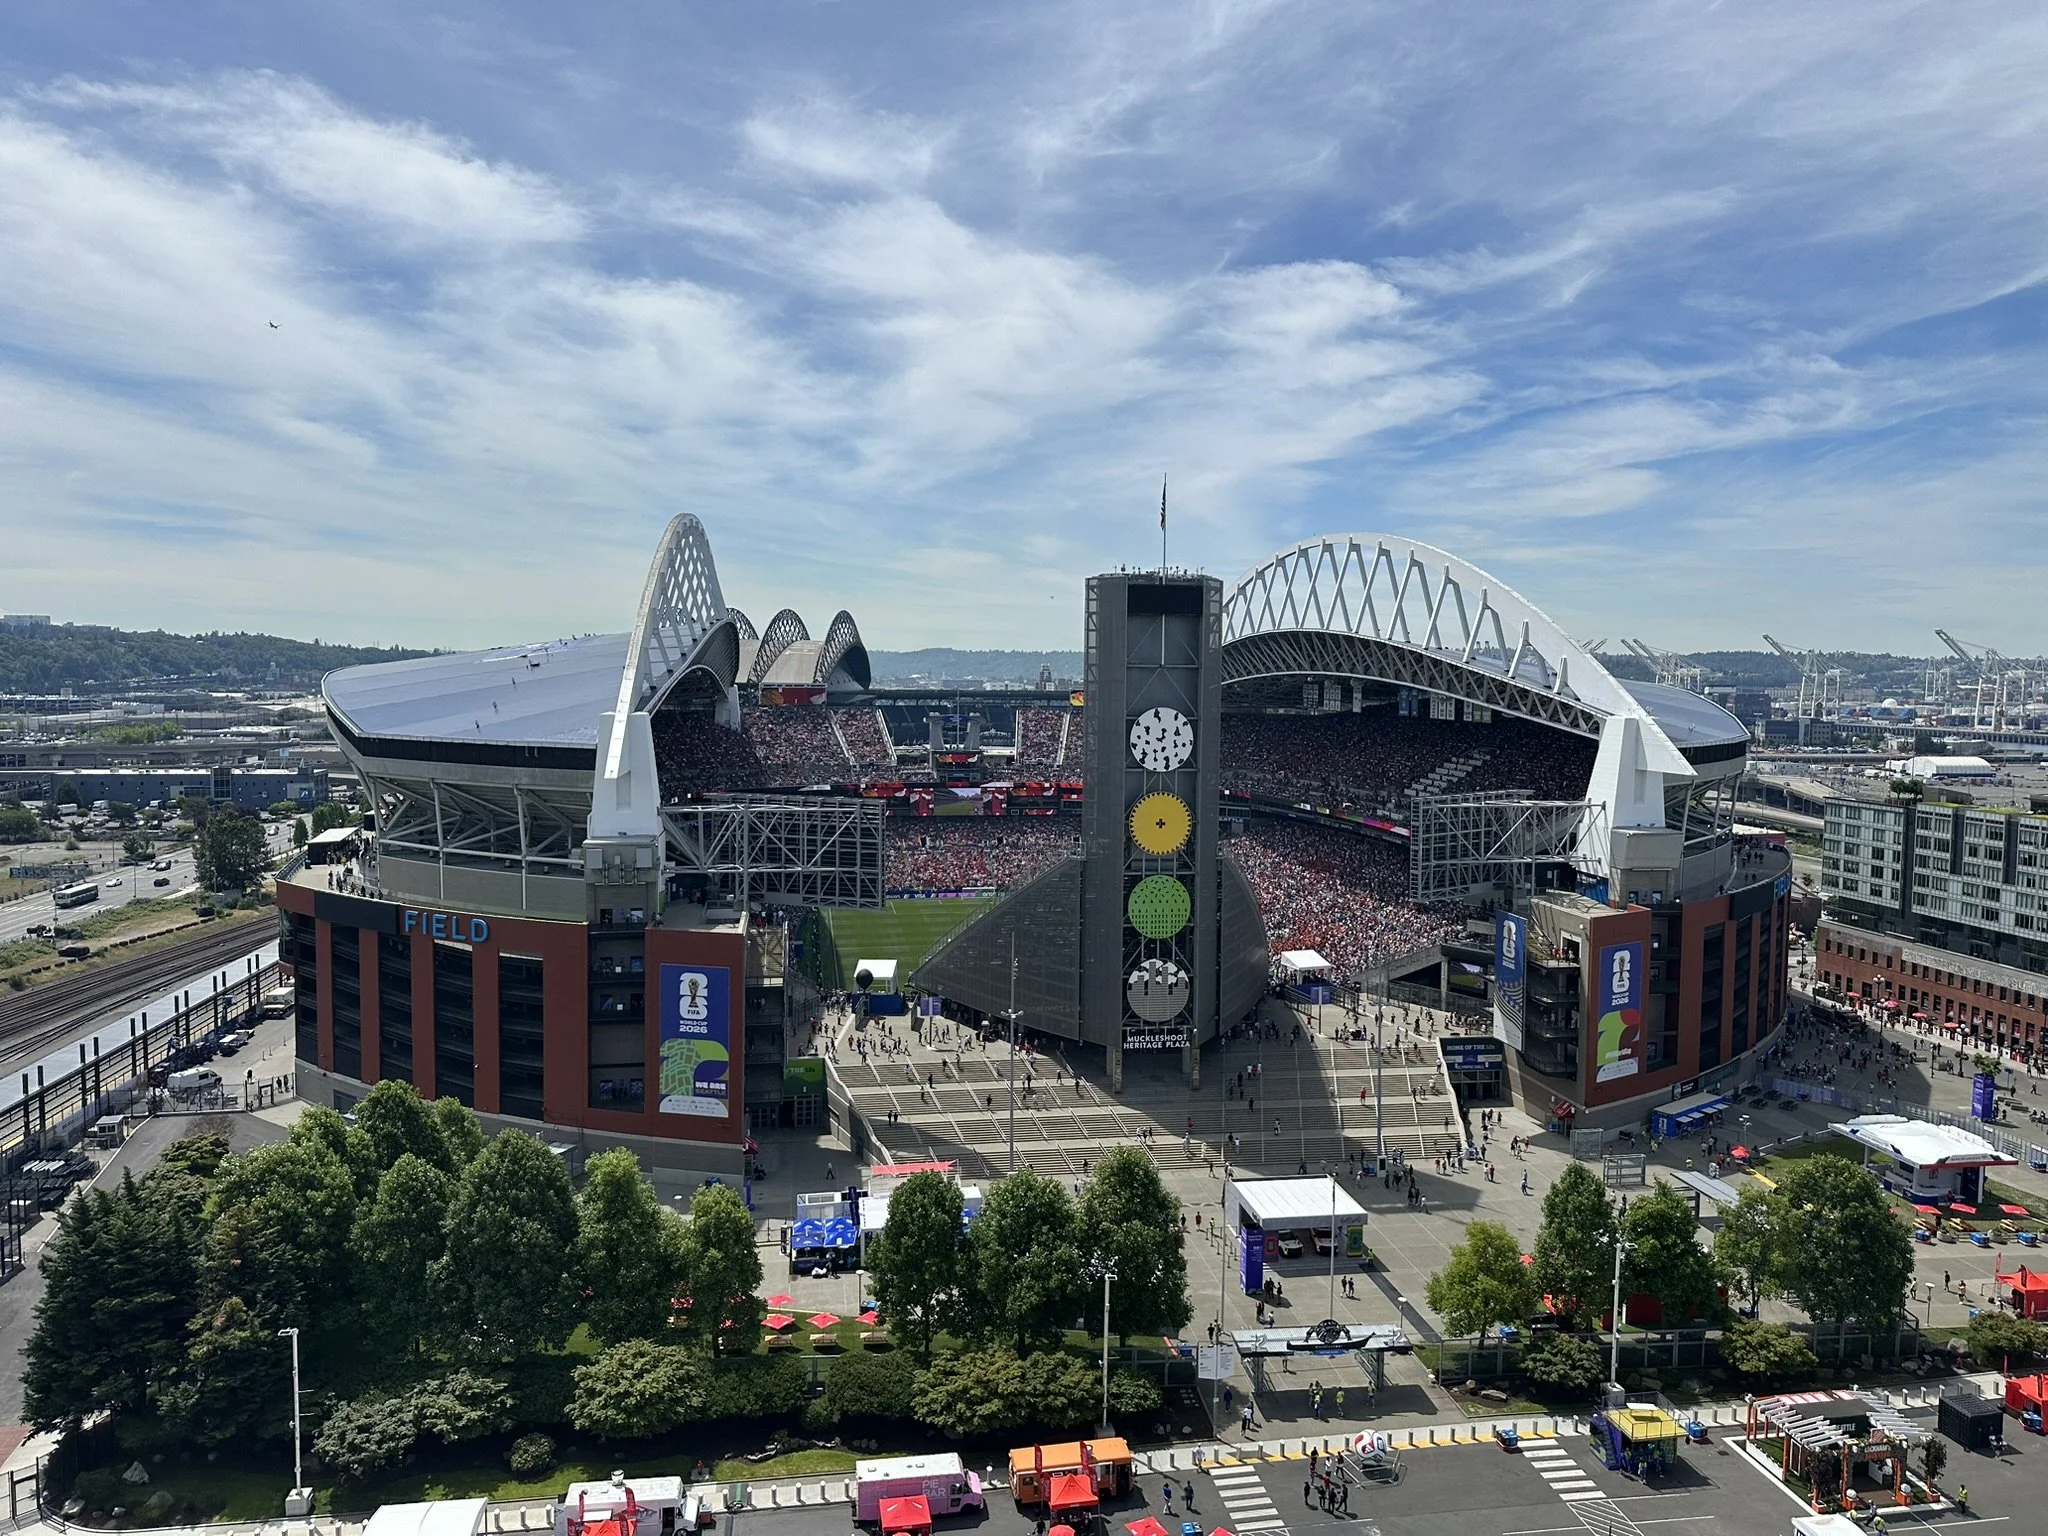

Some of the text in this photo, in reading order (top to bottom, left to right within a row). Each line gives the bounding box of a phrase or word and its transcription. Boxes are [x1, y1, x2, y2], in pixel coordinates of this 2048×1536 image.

[1218, 815, 1244, 823] EATTLE
[404, 909, 489, 943] FIELD
[679, 1024, 708, 1034] 2026
[1126, 1034, 1188, 1043] MUCKLESHOOT
[1123, 1040, 1191, 1050] HERITAGE PLAZA
[1836, 1423, 1856, 1433] EATTLE
[922, 1479, 939, 1489] PIE
[922, 1487, 946, 1497] BAR
